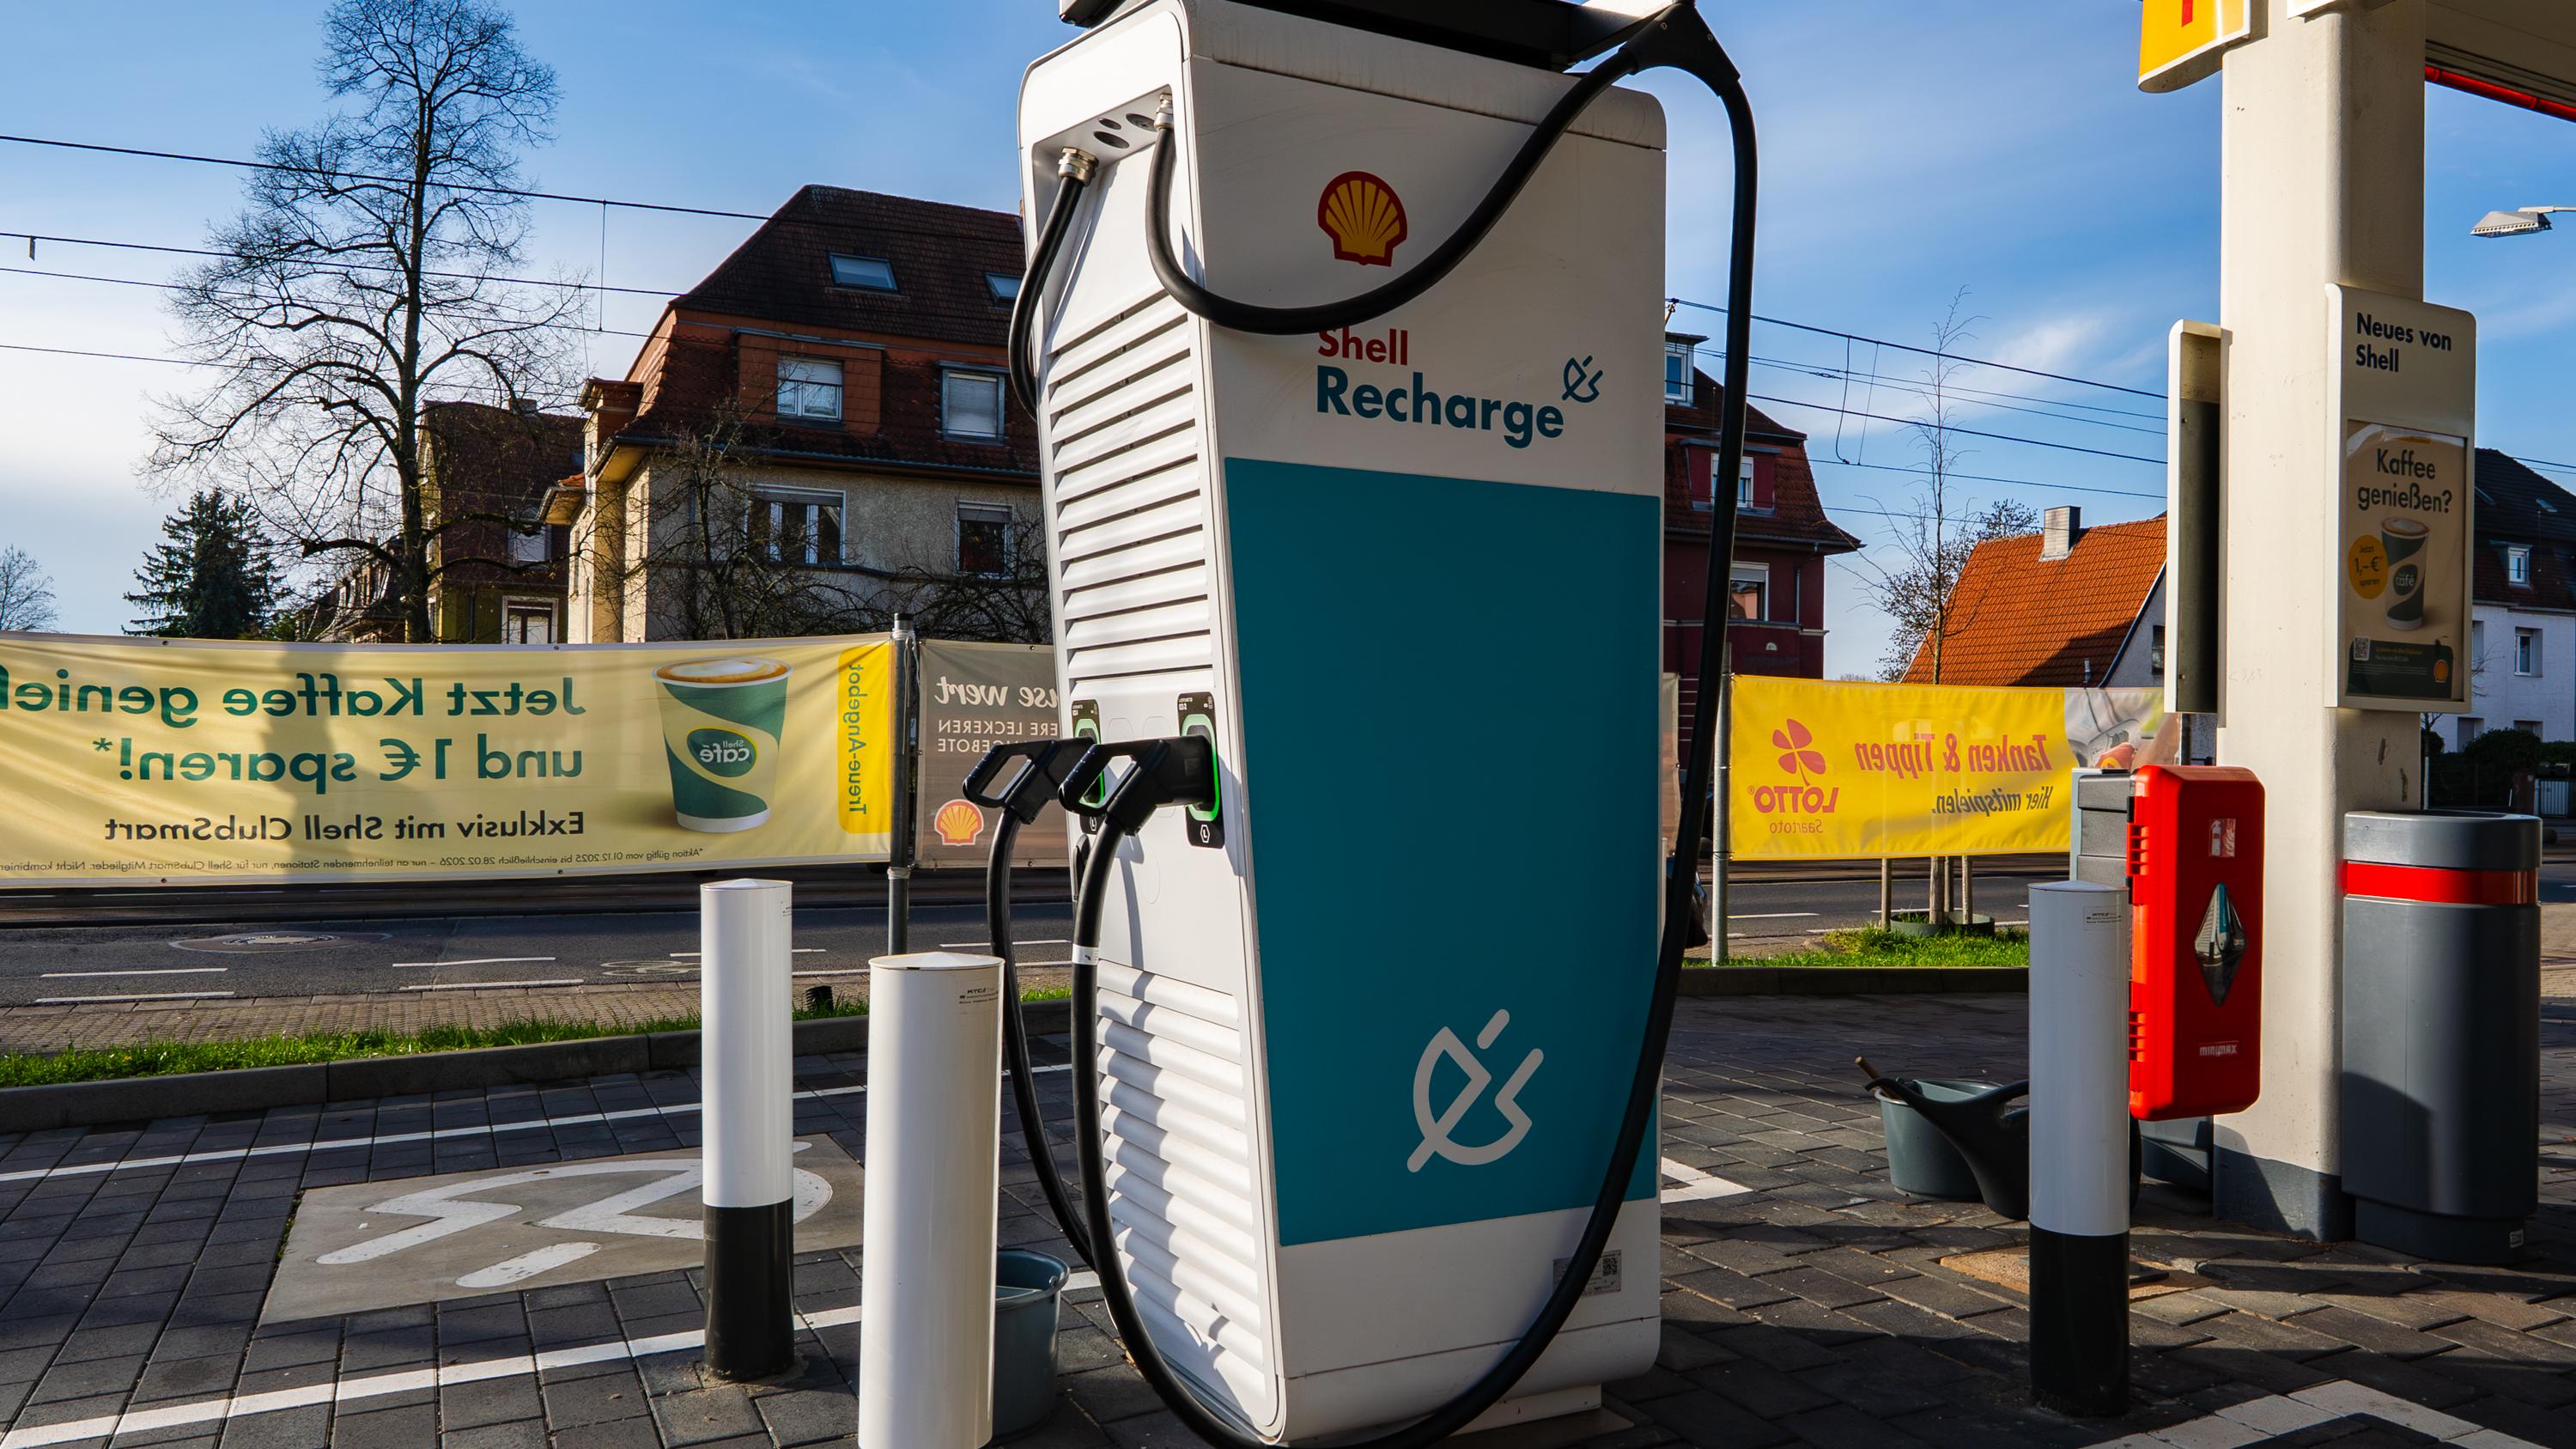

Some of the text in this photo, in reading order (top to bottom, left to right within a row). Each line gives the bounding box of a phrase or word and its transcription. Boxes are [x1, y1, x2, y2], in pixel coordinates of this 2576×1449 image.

[1317, 325, 1408, 366] Shell
[2356, 312, 2452, 351] Neues von
[2355, 344, 2399, 373] Shell
[1316, 364, 1564, 449] Recharge
[2377, 447, 2436, 480] Kaffee
[2357, 482, 2453, 514] genießen?
[2396, 573, 2415, 588] café
